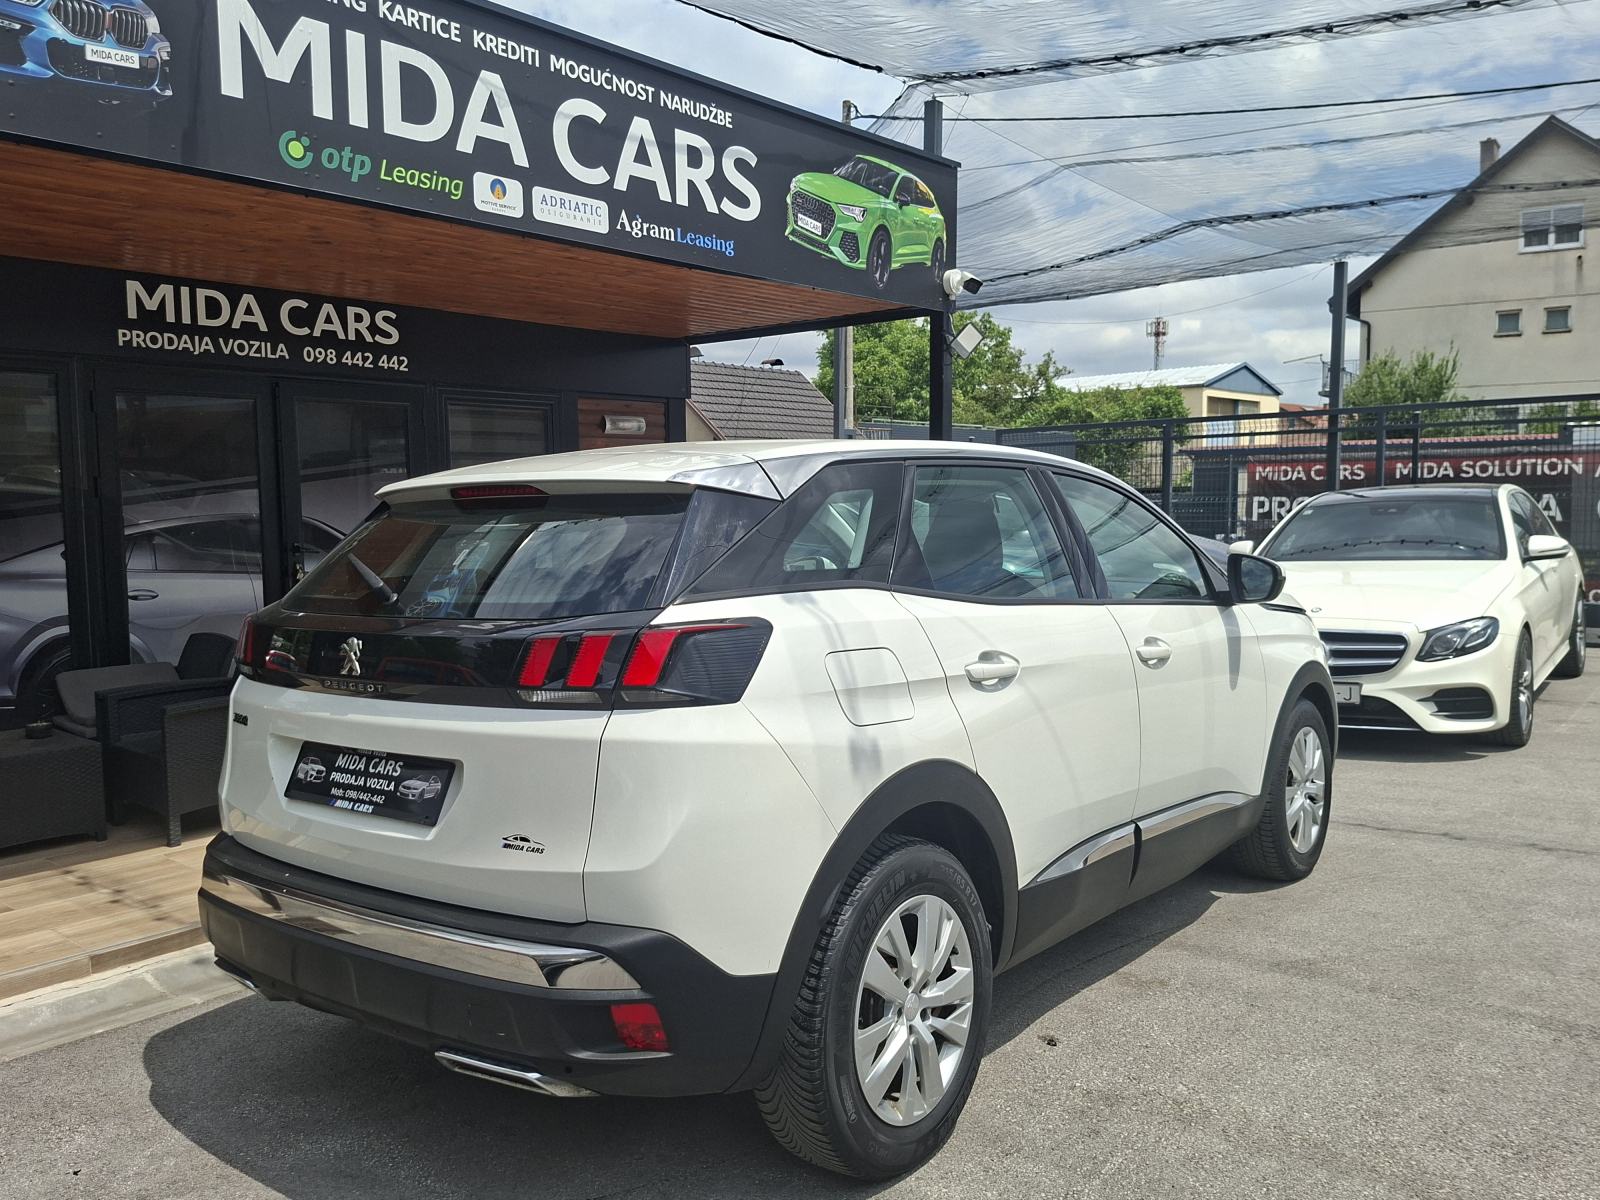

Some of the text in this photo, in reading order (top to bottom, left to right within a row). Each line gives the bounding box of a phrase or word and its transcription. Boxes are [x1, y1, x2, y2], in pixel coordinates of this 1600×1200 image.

[91, 48, 136, 65] MIDA CARS
[378, 1, 733, 128] KARTICE KREDITI MOGUĆNOST NARUDŽBE
[217, 0, 762, 222] MIDA CARS
[321, 146, 464, 200] otp Leasing
[540, 194, 602, 218] ADRIATIC
[126, 279, 400, 345] MIDA CARS
[117, 328, 409, 372] PRODAJA VOZILA 098 442 442
[1255, 463, 1366, 481] MIDA CRS
[1395, 460, 1455, 480] MIDA
[1460, 457, 1584, 478] SOLUTION
[324, 680, 383, 693] PEUGEOT
[334, 752, 404, 777] MIDA CARS
[329, 771, 395, 792] PRODAJA VOZILA
[330, 786, 386, 804] Mob: 098/442-442
[334, 799, 375, 813] MIDA CARS
[507, 843, 546, 855] MIDA CARS
